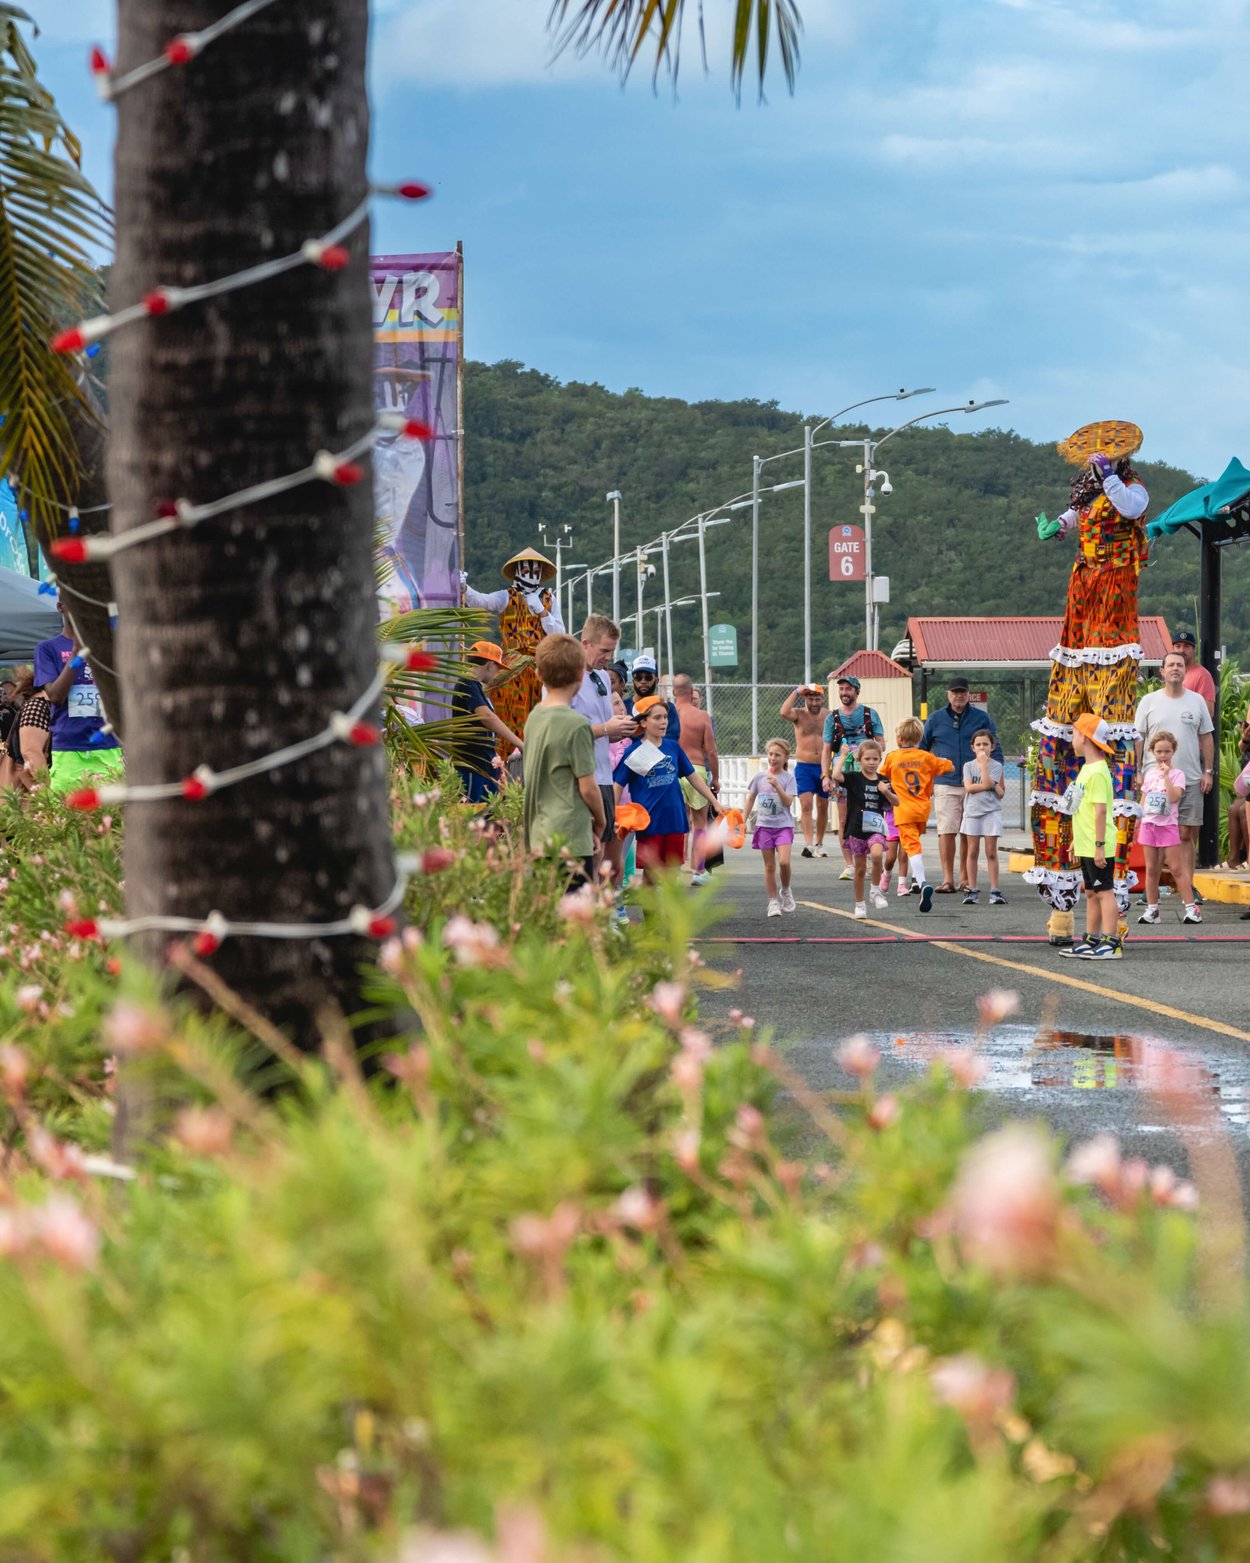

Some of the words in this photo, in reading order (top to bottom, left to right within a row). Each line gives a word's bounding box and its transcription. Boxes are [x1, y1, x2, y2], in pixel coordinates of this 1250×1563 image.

[834, 541, 860, 553] GATE
[841, 556, 854, 576] 6
[904, 771, 920, 797] 9
[762, 798, 775, 809] 67
